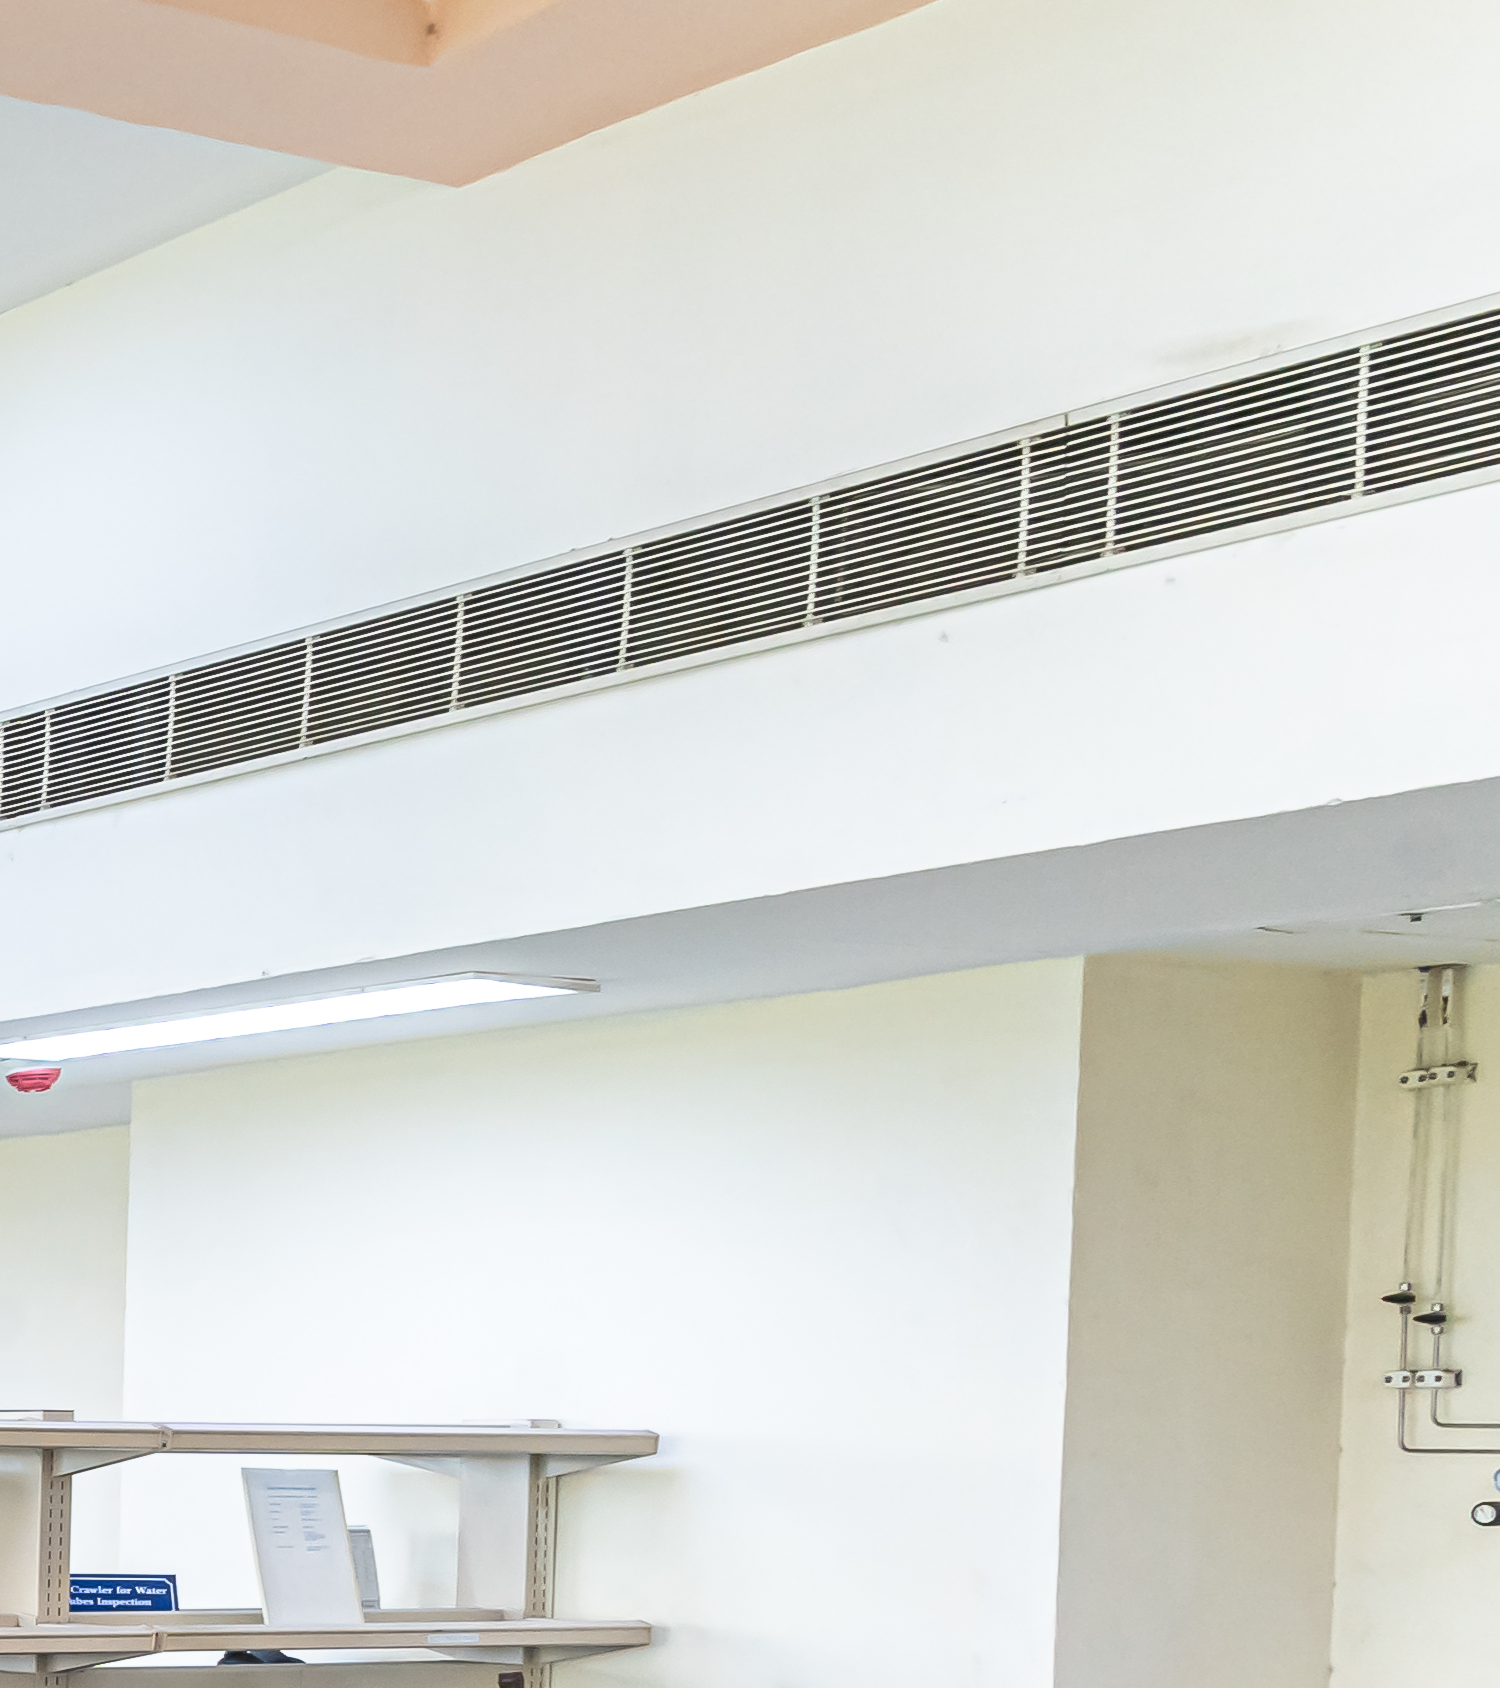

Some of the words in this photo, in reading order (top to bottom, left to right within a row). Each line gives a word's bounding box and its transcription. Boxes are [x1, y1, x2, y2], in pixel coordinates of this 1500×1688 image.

[70, 1585, 114, 1595] Crawler
[116, 1585, 133, 1595] for
[135, 1586, 168, 1595] Water
[96, 1597, 152, 1608] Inspection
